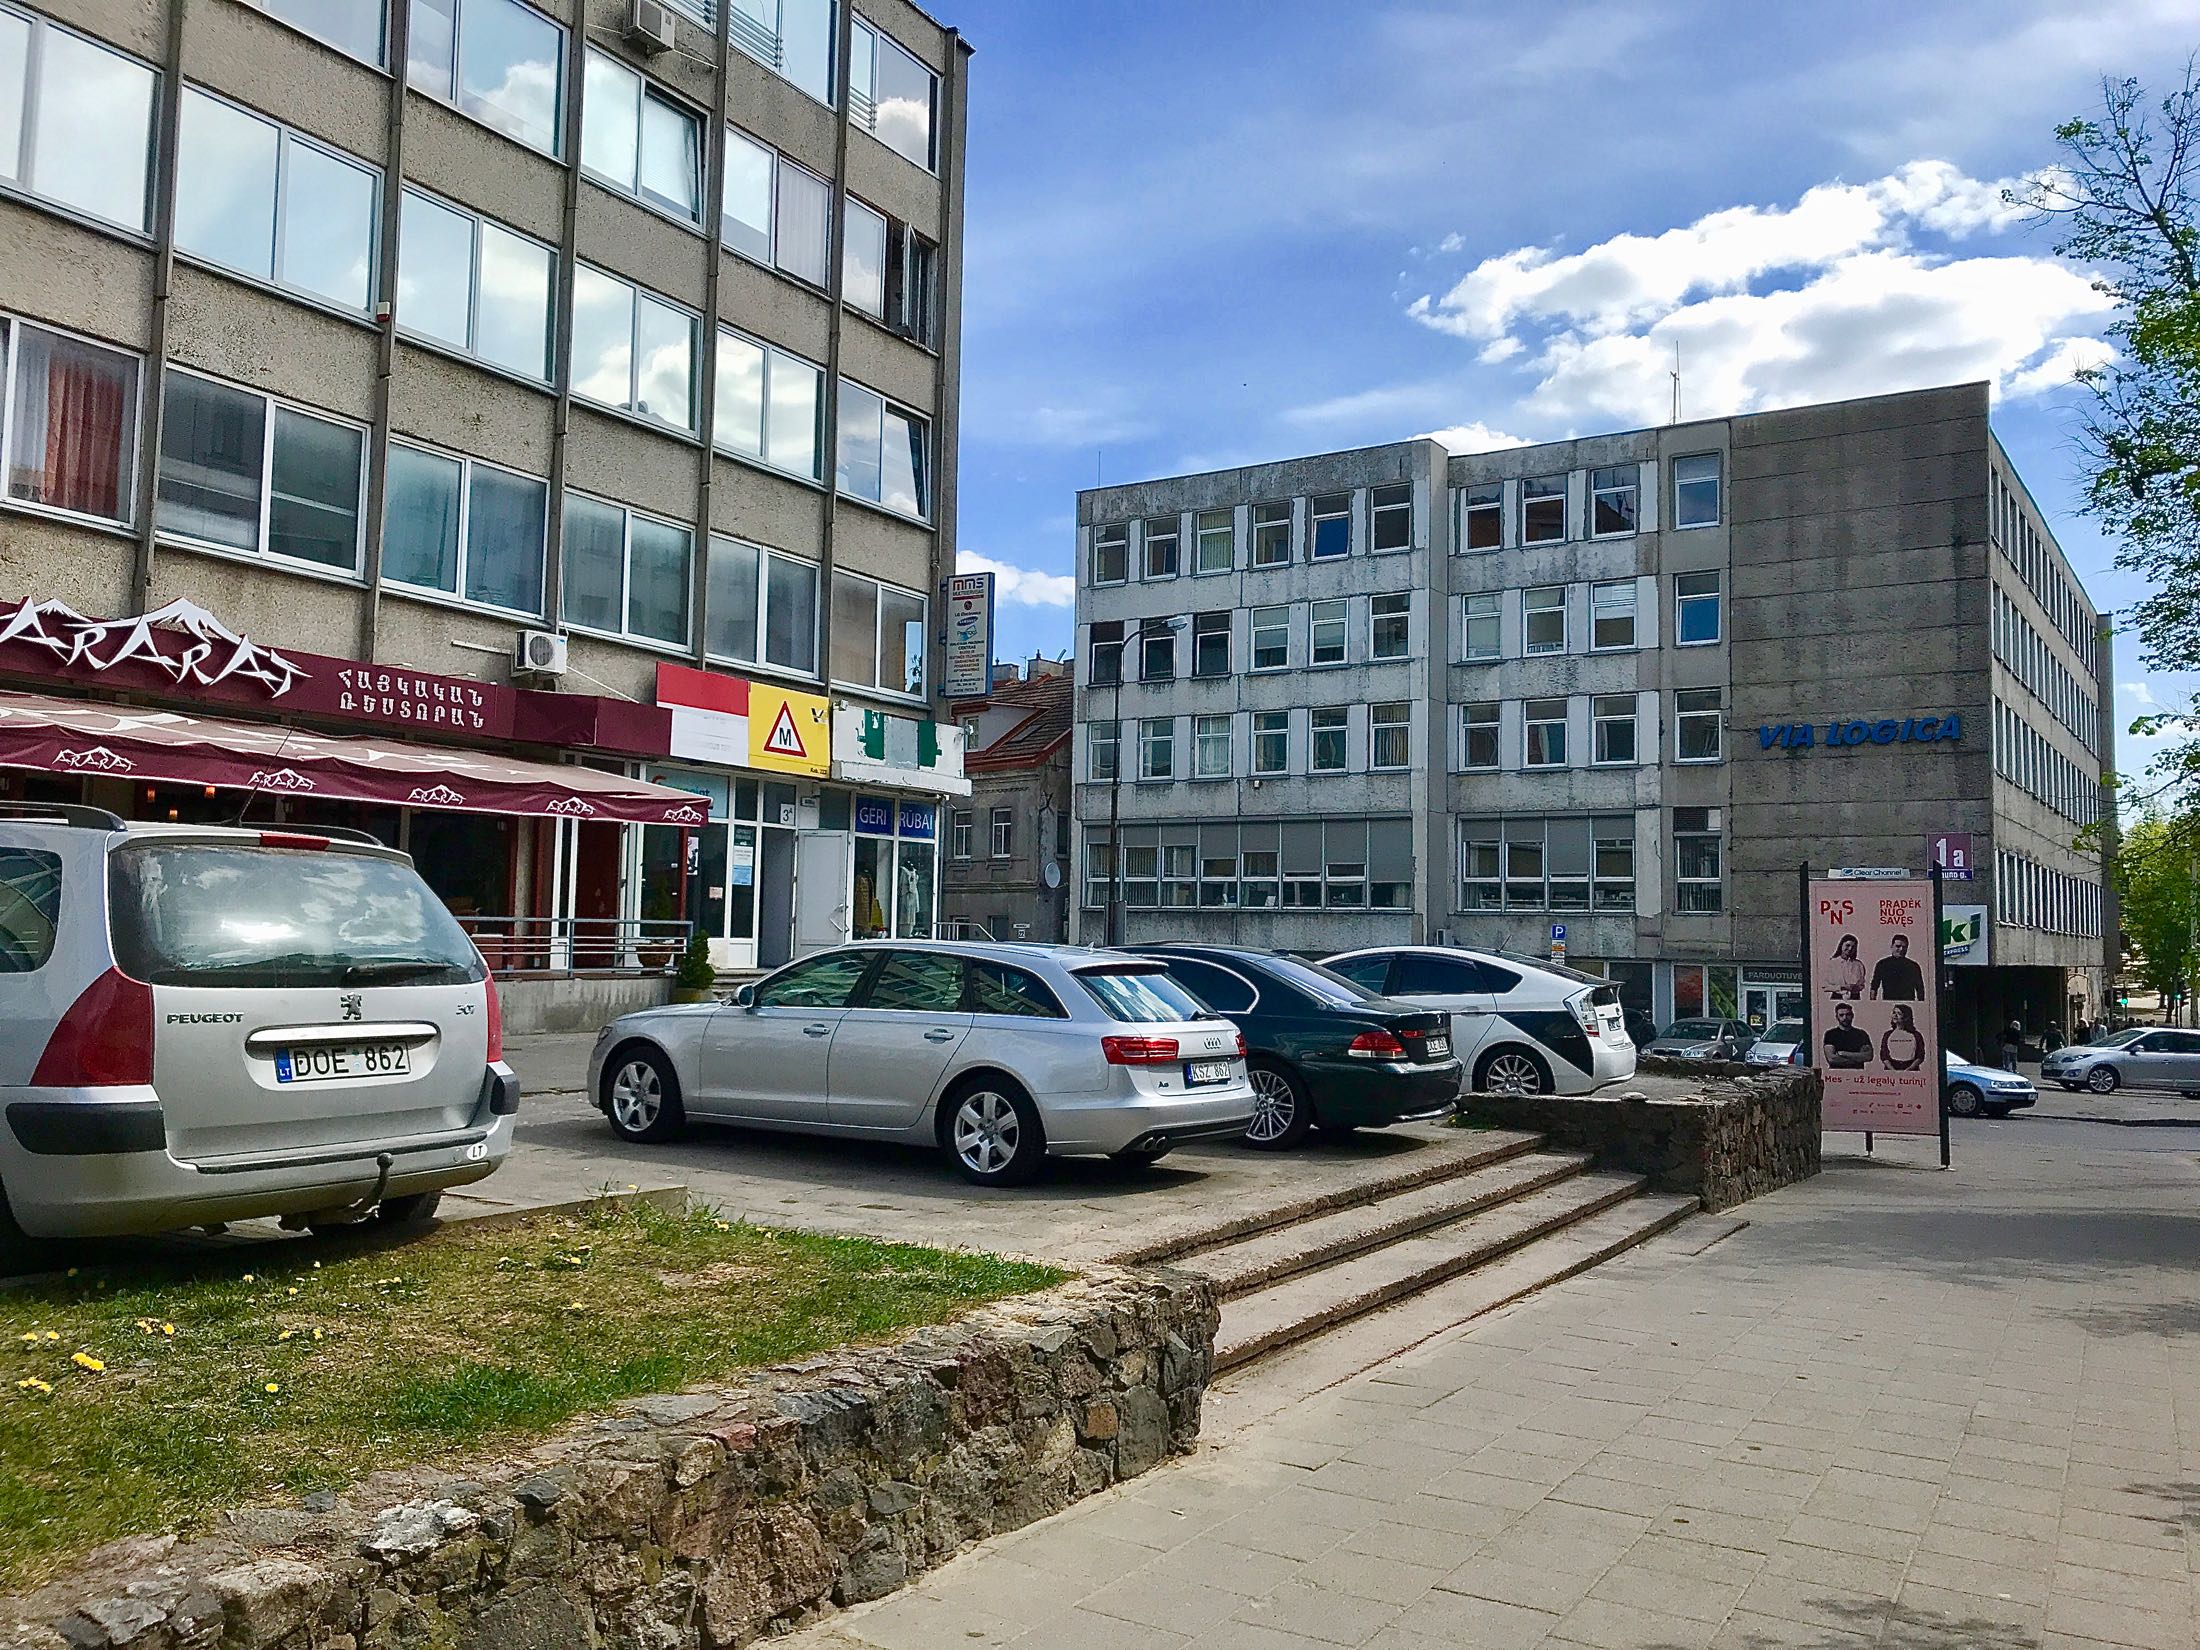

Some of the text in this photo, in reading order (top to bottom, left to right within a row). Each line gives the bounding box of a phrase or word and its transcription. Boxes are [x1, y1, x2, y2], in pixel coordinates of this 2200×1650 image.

[0, 597, 313, 698] ARARAT
[338, 669, 483, 707] ՀԱՅԿԱԿԱՆ
[779, 727, 791, 747] M
[1760, 713, 1961, 750] VIA LOGICA
[52, 746, 137, 772] ARARAT
[247, 768, 317, 790] ARARAT
[407, 784, 466, 805] ARARAT
[859, 807, 933, 830] GERI RŪBAI
[1879, 898, 1921, 909] PRADĖK
[1879, 908, 1905, 917] NUO
[1555, 926, 1564, 938] P
[1943, 912, 1981, 945] ki
[166, 1012, 244, 1024] PEUGEOT
[279, 1045, 406, 1077] LT DOE 862
[1192, 1063, 1211, 1080] KSZ
[1824, 1075, 1842, 1083] Mes
[471, 1145, 483, 1158] LT
